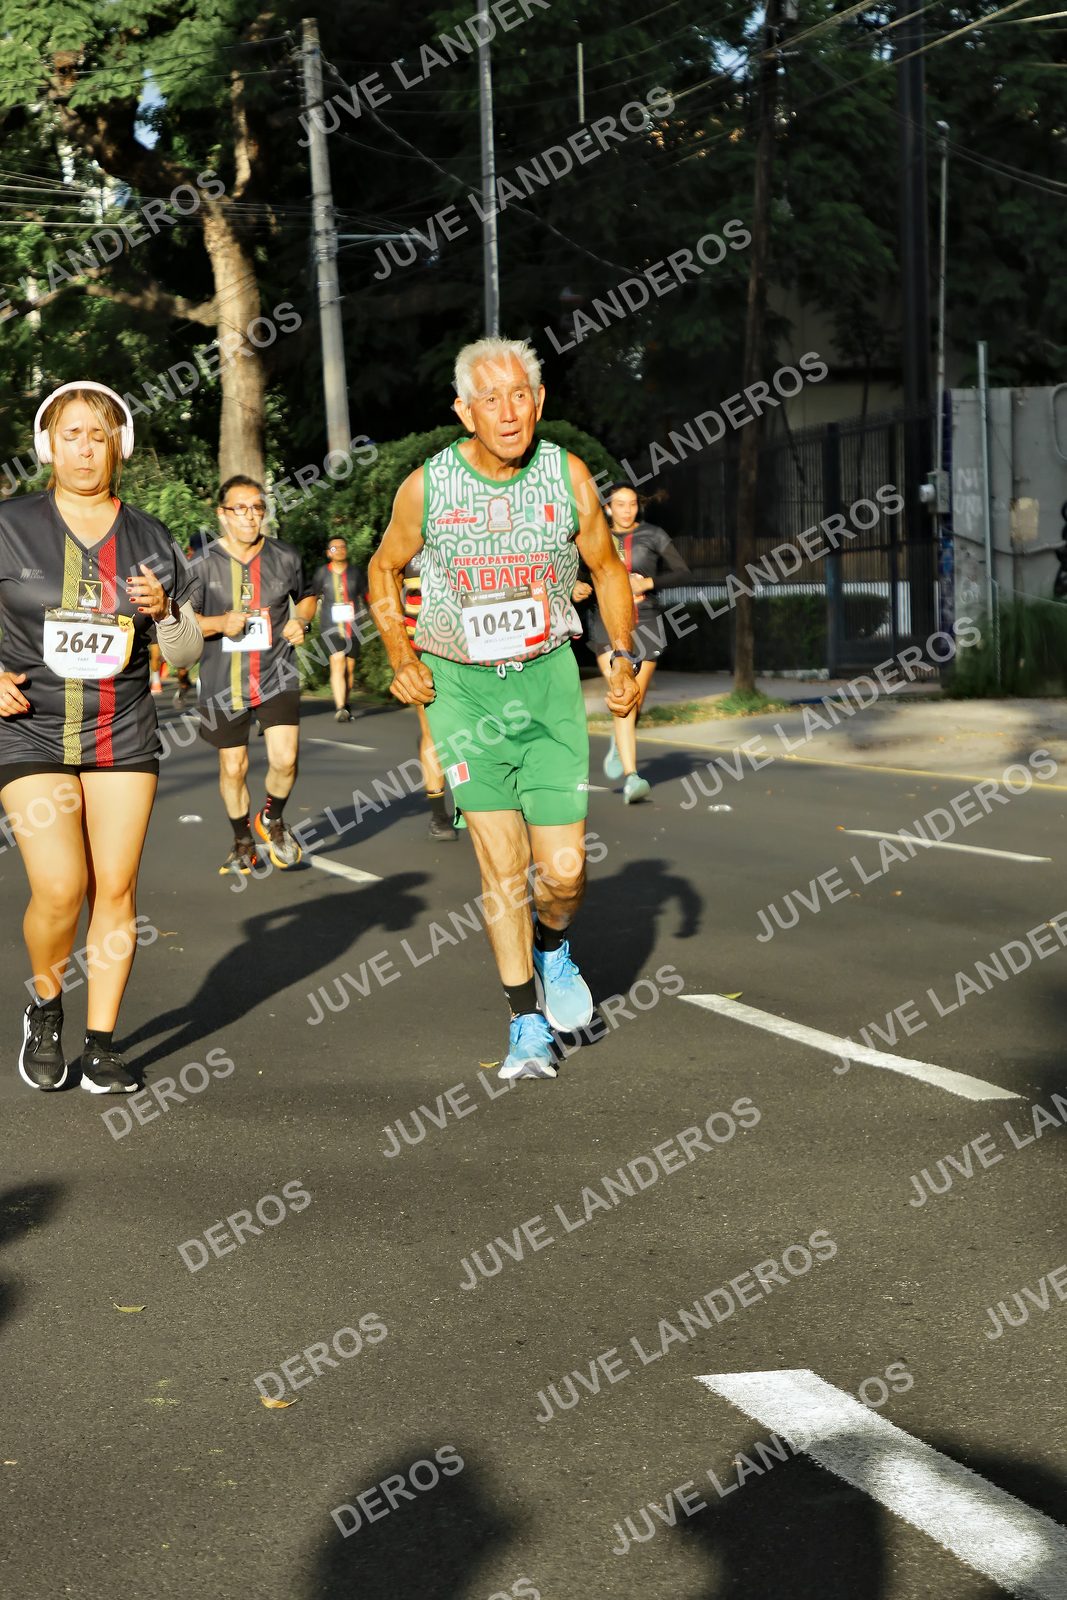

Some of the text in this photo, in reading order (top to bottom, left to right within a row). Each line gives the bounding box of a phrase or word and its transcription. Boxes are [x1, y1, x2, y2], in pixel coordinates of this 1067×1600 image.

[453, 552, 550, 567] FUEGO PATRIO 2025
[479, 563, 557, 591] BARCA
[248, 622, 263, 635] 61
[469, 607, 537, 637] 10421
[55, 630, 114, 654] 2647
